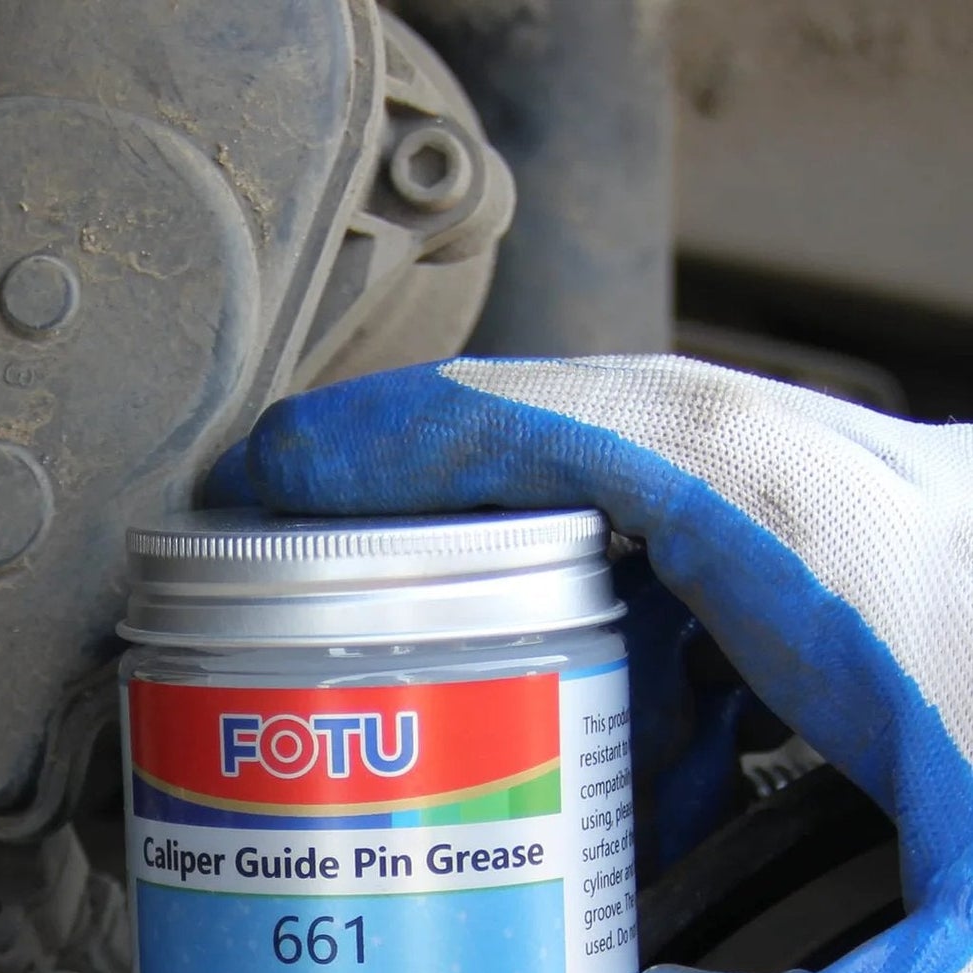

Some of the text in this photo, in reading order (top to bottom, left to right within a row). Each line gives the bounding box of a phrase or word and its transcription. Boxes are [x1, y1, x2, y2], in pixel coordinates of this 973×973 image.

[583, 713, 606, 735] This
[219, 711, 419, 779] FOTU
[580, 741, 621, 768] resistant
[581, 809, 613, 831] using,
[143, 836, 545, 881] Caliper Guide Pin Grease
[582, 838, 619, 862] surface
[583, 866, 623, 898] cylinder
[584, 901, 623, 930] groove.
[273, 915, 365, 964] 661
[586, 930, 615, 956] used.
